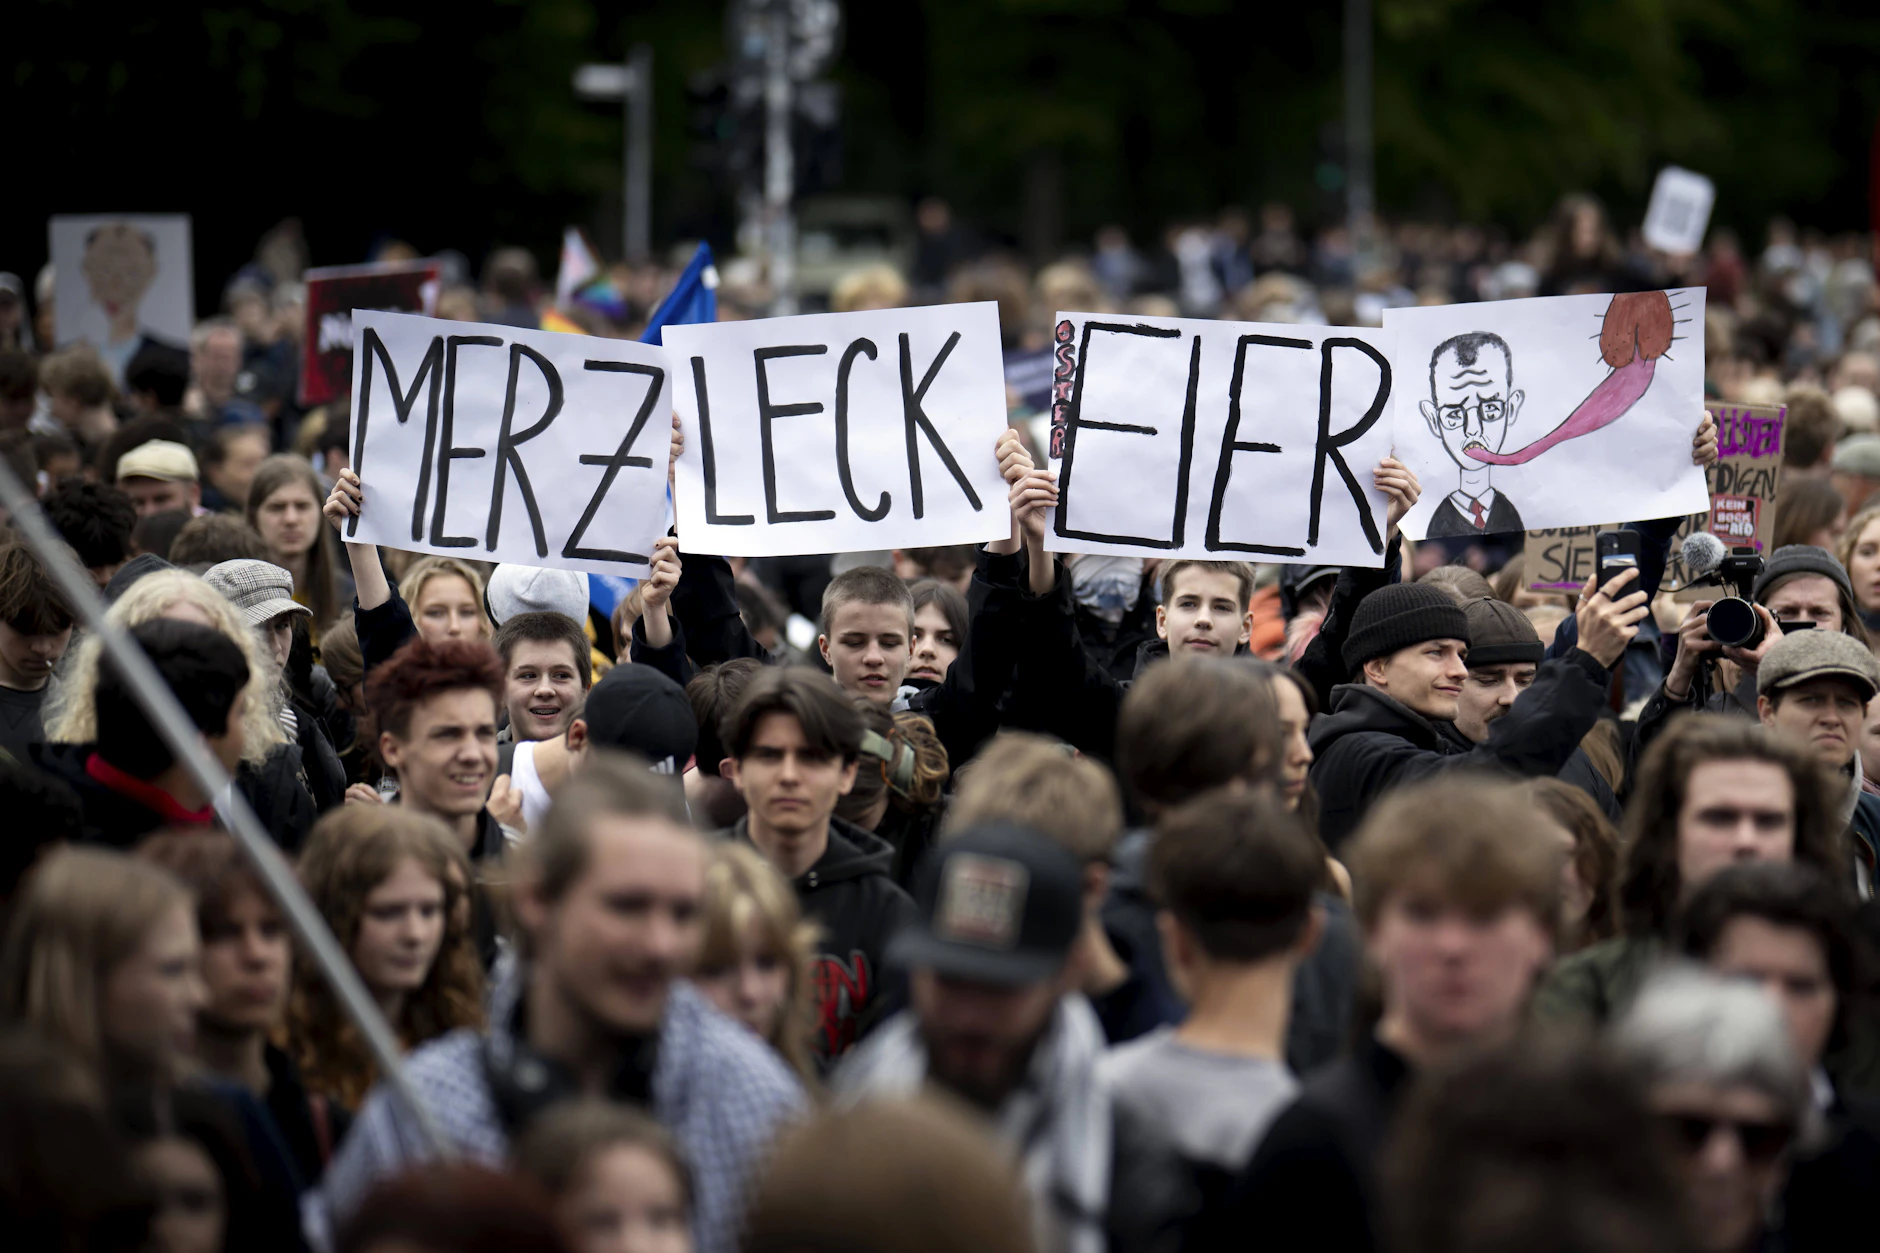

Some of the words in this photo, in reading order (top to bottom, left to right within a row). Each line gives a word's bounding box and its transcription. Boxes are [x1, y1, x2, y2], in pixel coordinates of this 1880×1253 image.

[346, 326, 665, 566] MERZ
[690, 330, 983, 525] LECK
[1049, 319, 1076, 460] OSTER
[1053, 321, 1392, 557] EIER
[1538, 540, 1594, 583] SIE
[1716, 499, 1747, 511] KEIN
[1717, 511, 1752, 523] BOCK
